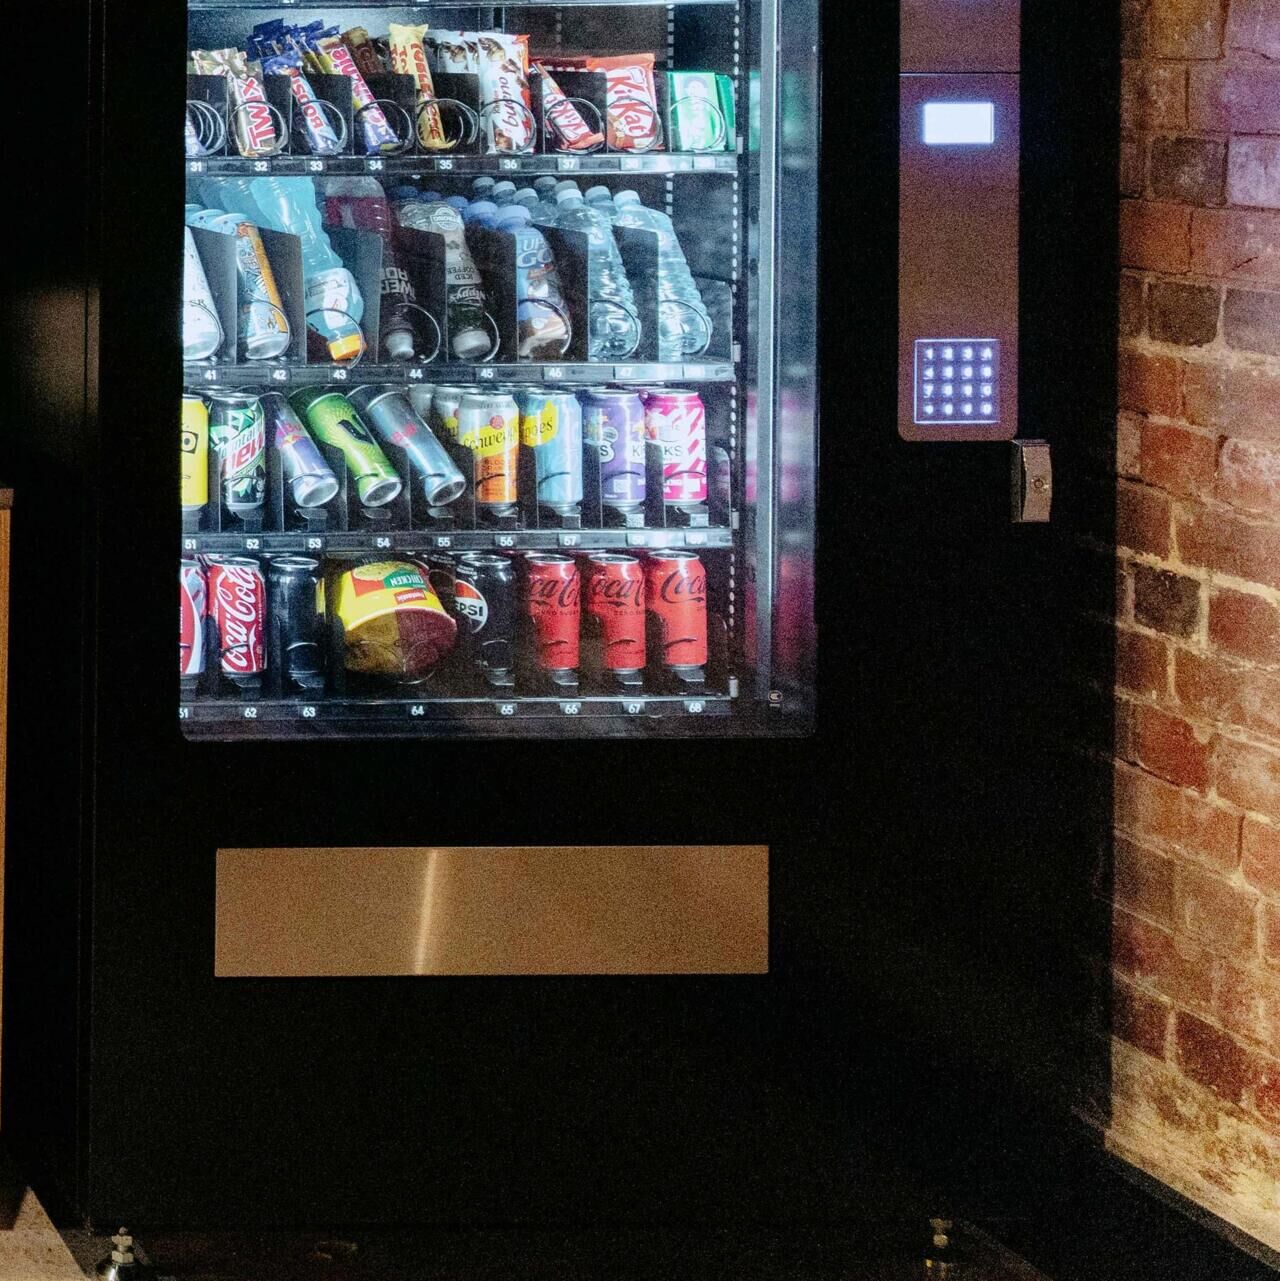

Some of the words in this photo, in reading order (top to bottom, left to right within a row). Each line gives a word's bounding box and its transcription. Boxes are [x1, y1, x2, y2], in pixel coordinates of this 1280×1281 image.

[499, 76, 520, 129] bueno
[243, 78, 276, 150] TWIX
[190, 162, 202, 171] 31
[254, 162, 267, 171] 32
[310, 162, 323, 171] 33
[369, 161, 383, 170] 34
[439, 160, 453, 170] 35
[504, 160, 517, 169] 36
[562, 159, 575, 169] 37
[523, 237, 545, 252] UP
[517, 248, 553, 268] GO
[454, 273, 474, 282] ICED
[204, 370, 217, 380] 41
[272, 370, 286, 380] 42
[333, 370, 346, 379] 43
[409, 369, 423, 378] 44
[480, 368, 494, 378] 45
[548, 368, 562, 377] 46
[184, 539, 196, 549] 51
[246, 539, 259, 549] 52
[308, 538, 321, 548] 53
[377, 537, 390, 547] 54
[438, 537, 451, 547] 55
[500, 536, 513, 546] 56
[564, 536, 576, 545] 57
[390, 575, 425, 587] CHICKEN
[454, 601, 483, 617] EPSI
[303, 707, 316, 717] 63
[411, 705, 425, 716] 64
[500, 705, 514, 715] 65
[564, 704, 578, 713] 66
[628, 703, 641, 713] 67
[688, 702, 702, 712] 68
[244, 708, 257, 717] 62
